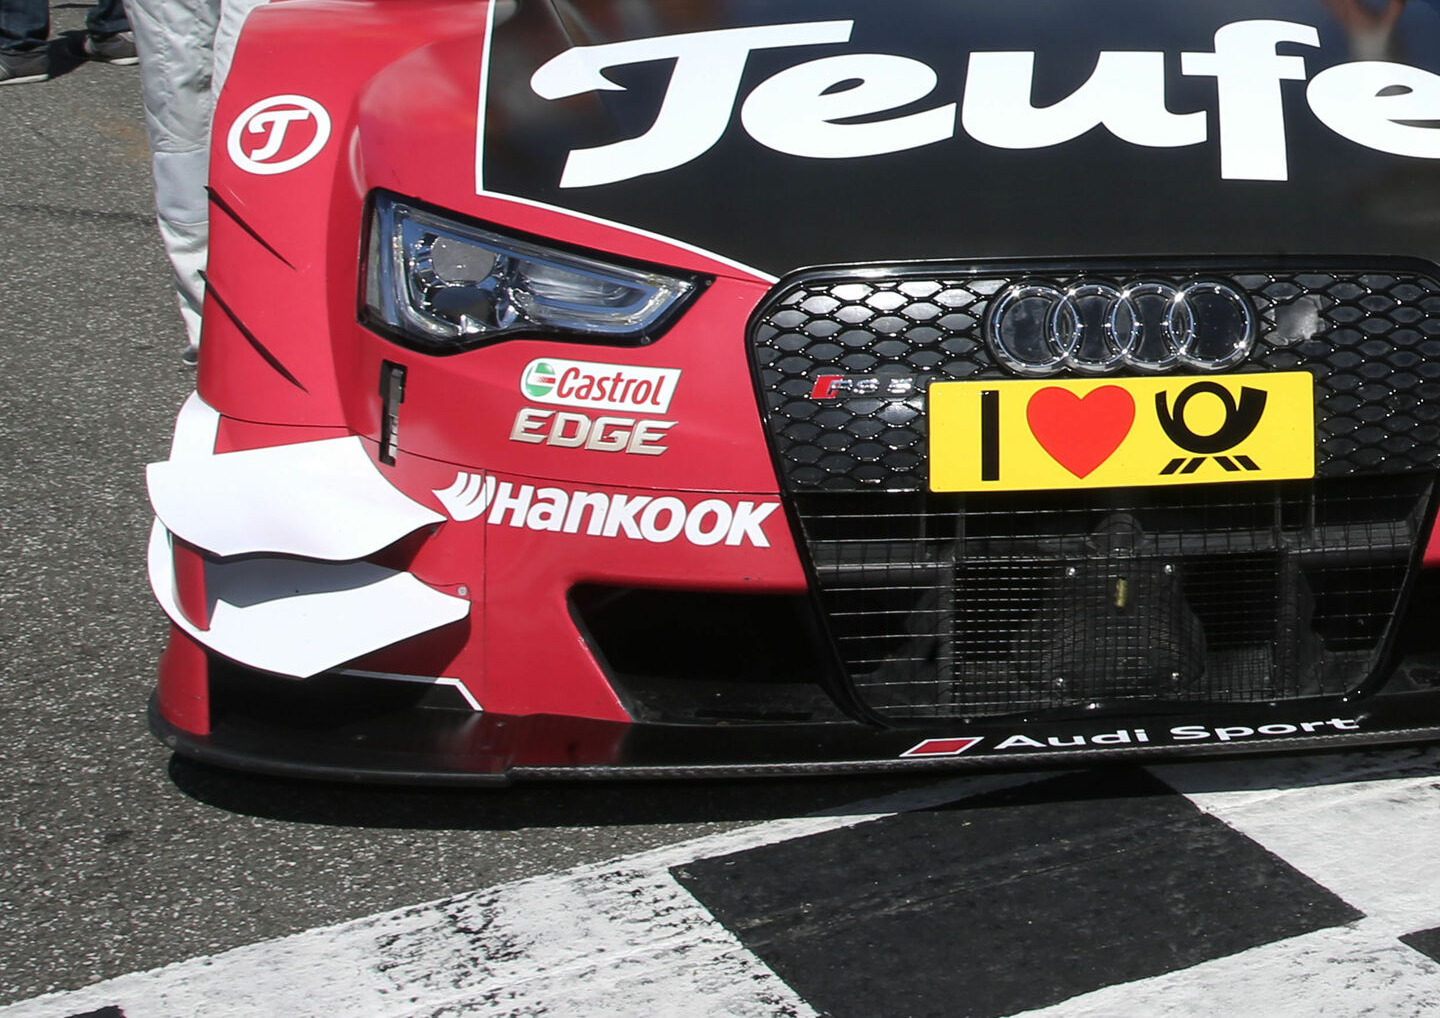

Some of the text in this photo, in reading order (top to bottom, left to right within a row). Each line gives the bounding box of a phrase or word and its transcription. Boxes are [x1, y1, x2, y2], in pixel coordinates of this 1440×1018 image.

[556, 368, 664, 406] Castrol
[509, 408, 679, 455] EDGE
[980, 389, 1000, 482] I
[993, 716, 1363, 750] Audi Sport
